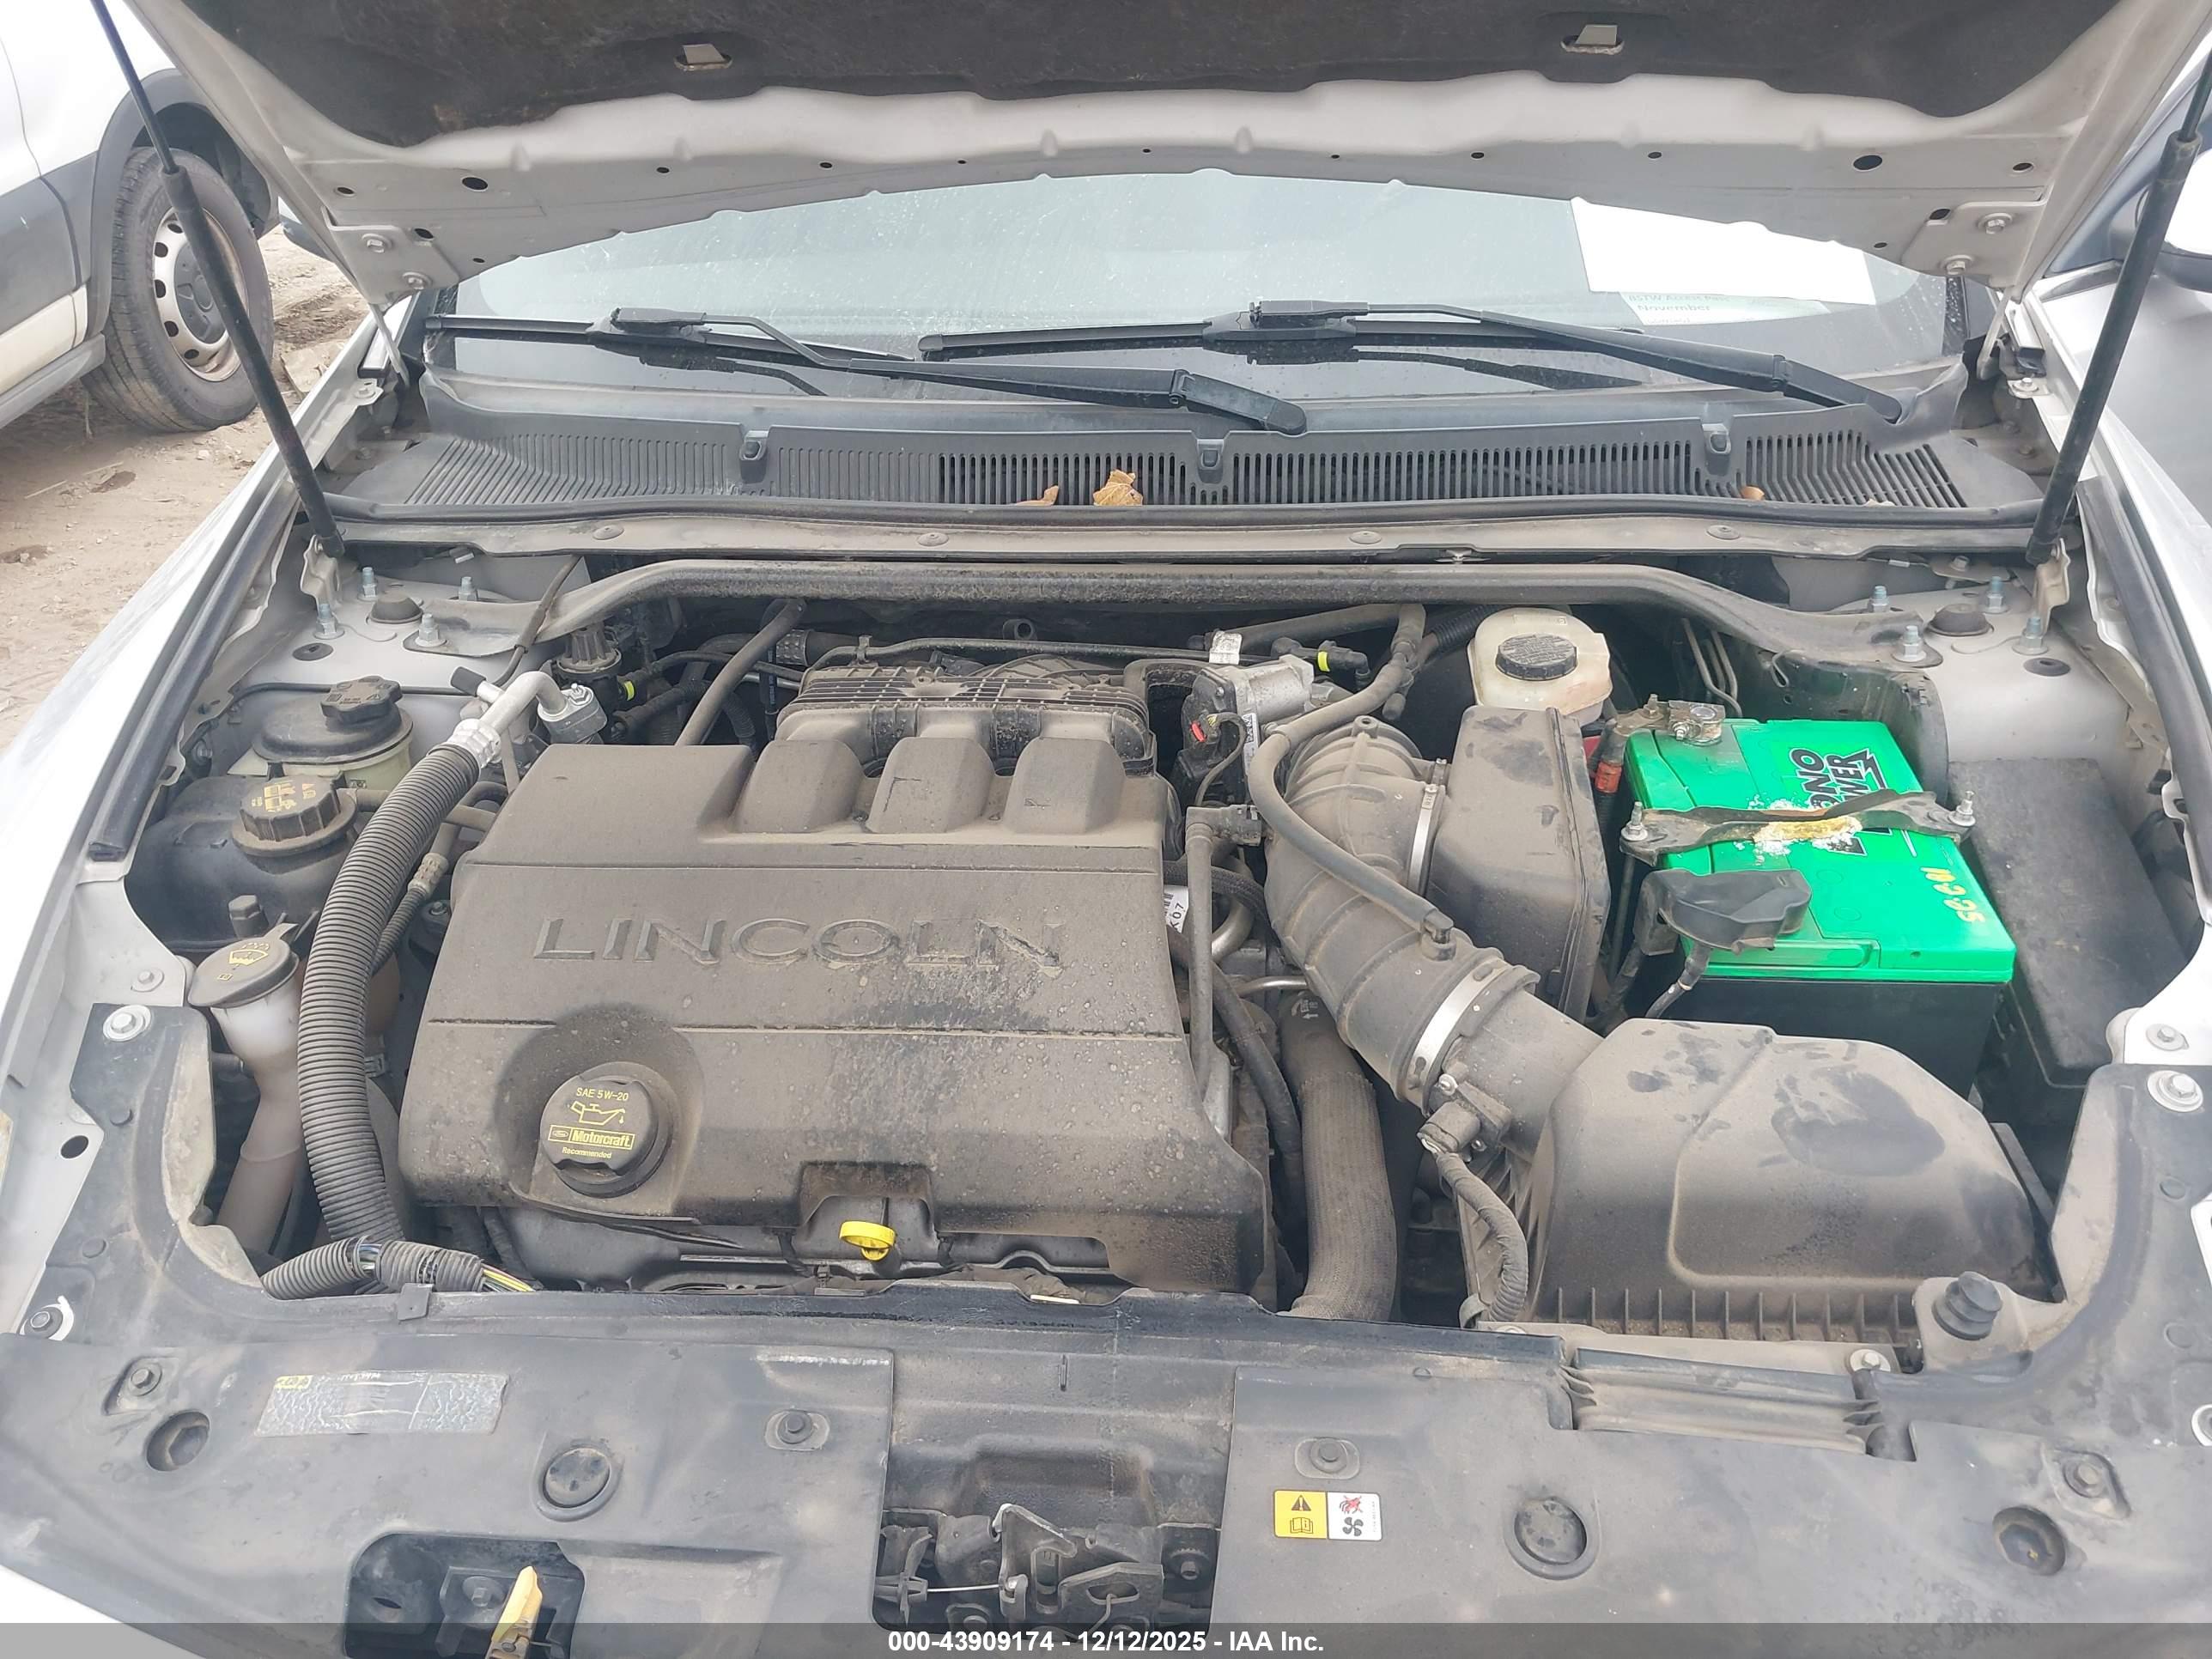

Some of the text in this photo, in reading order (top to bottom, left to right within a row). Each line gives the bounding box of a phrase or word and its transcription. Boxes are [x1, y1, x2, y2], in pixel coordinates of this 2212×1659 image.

[1638, 303, 1711, 312] November
[533, 916, 1064, 967] LINCOLN
[575, 1087, 629, 1102] SAE 5W-20
[562, 1146, 612, 1159] Recommended
